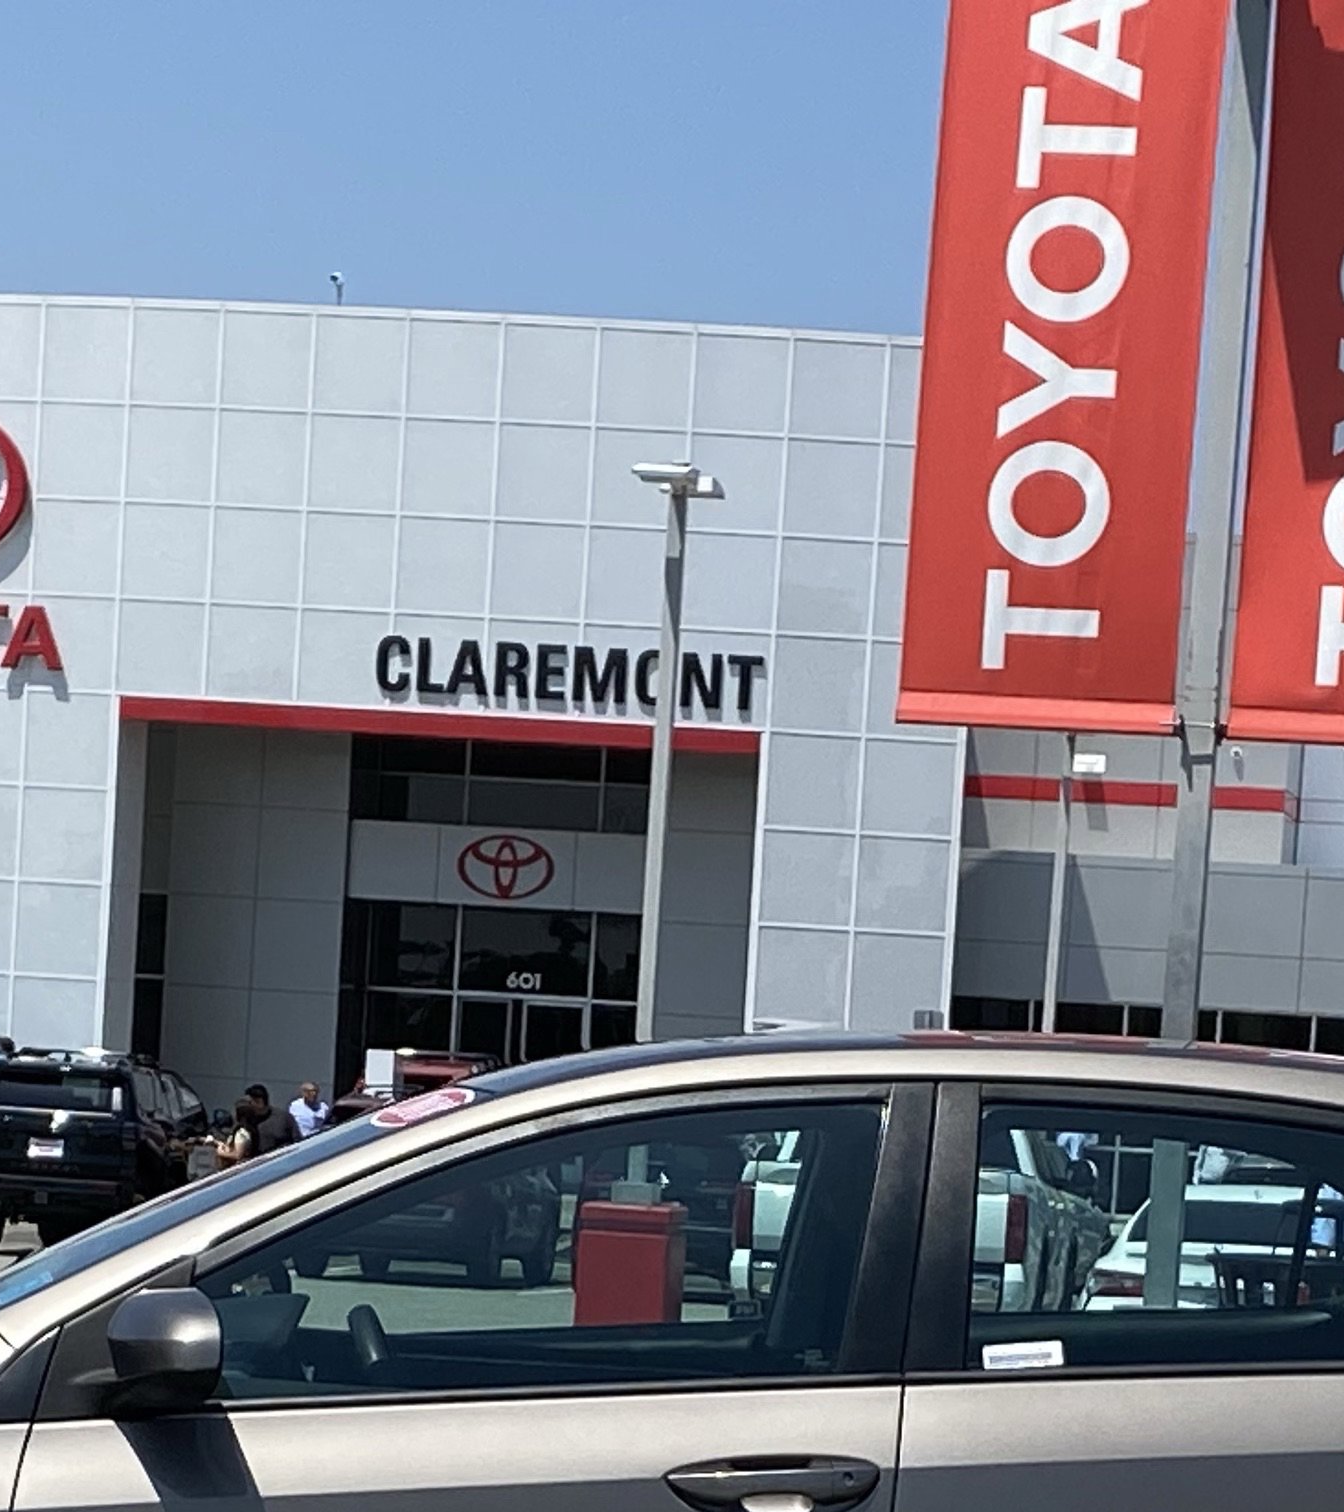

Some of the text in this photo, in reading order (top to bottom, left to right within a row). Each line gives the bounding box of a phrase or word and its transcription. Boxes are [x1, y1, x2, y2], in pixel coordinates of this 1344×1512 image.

[981, 0, 1144, 670] TOYOTA
[375, 634, 765, 712] CLAREMONT
[505, 971, 542, 991] 601
